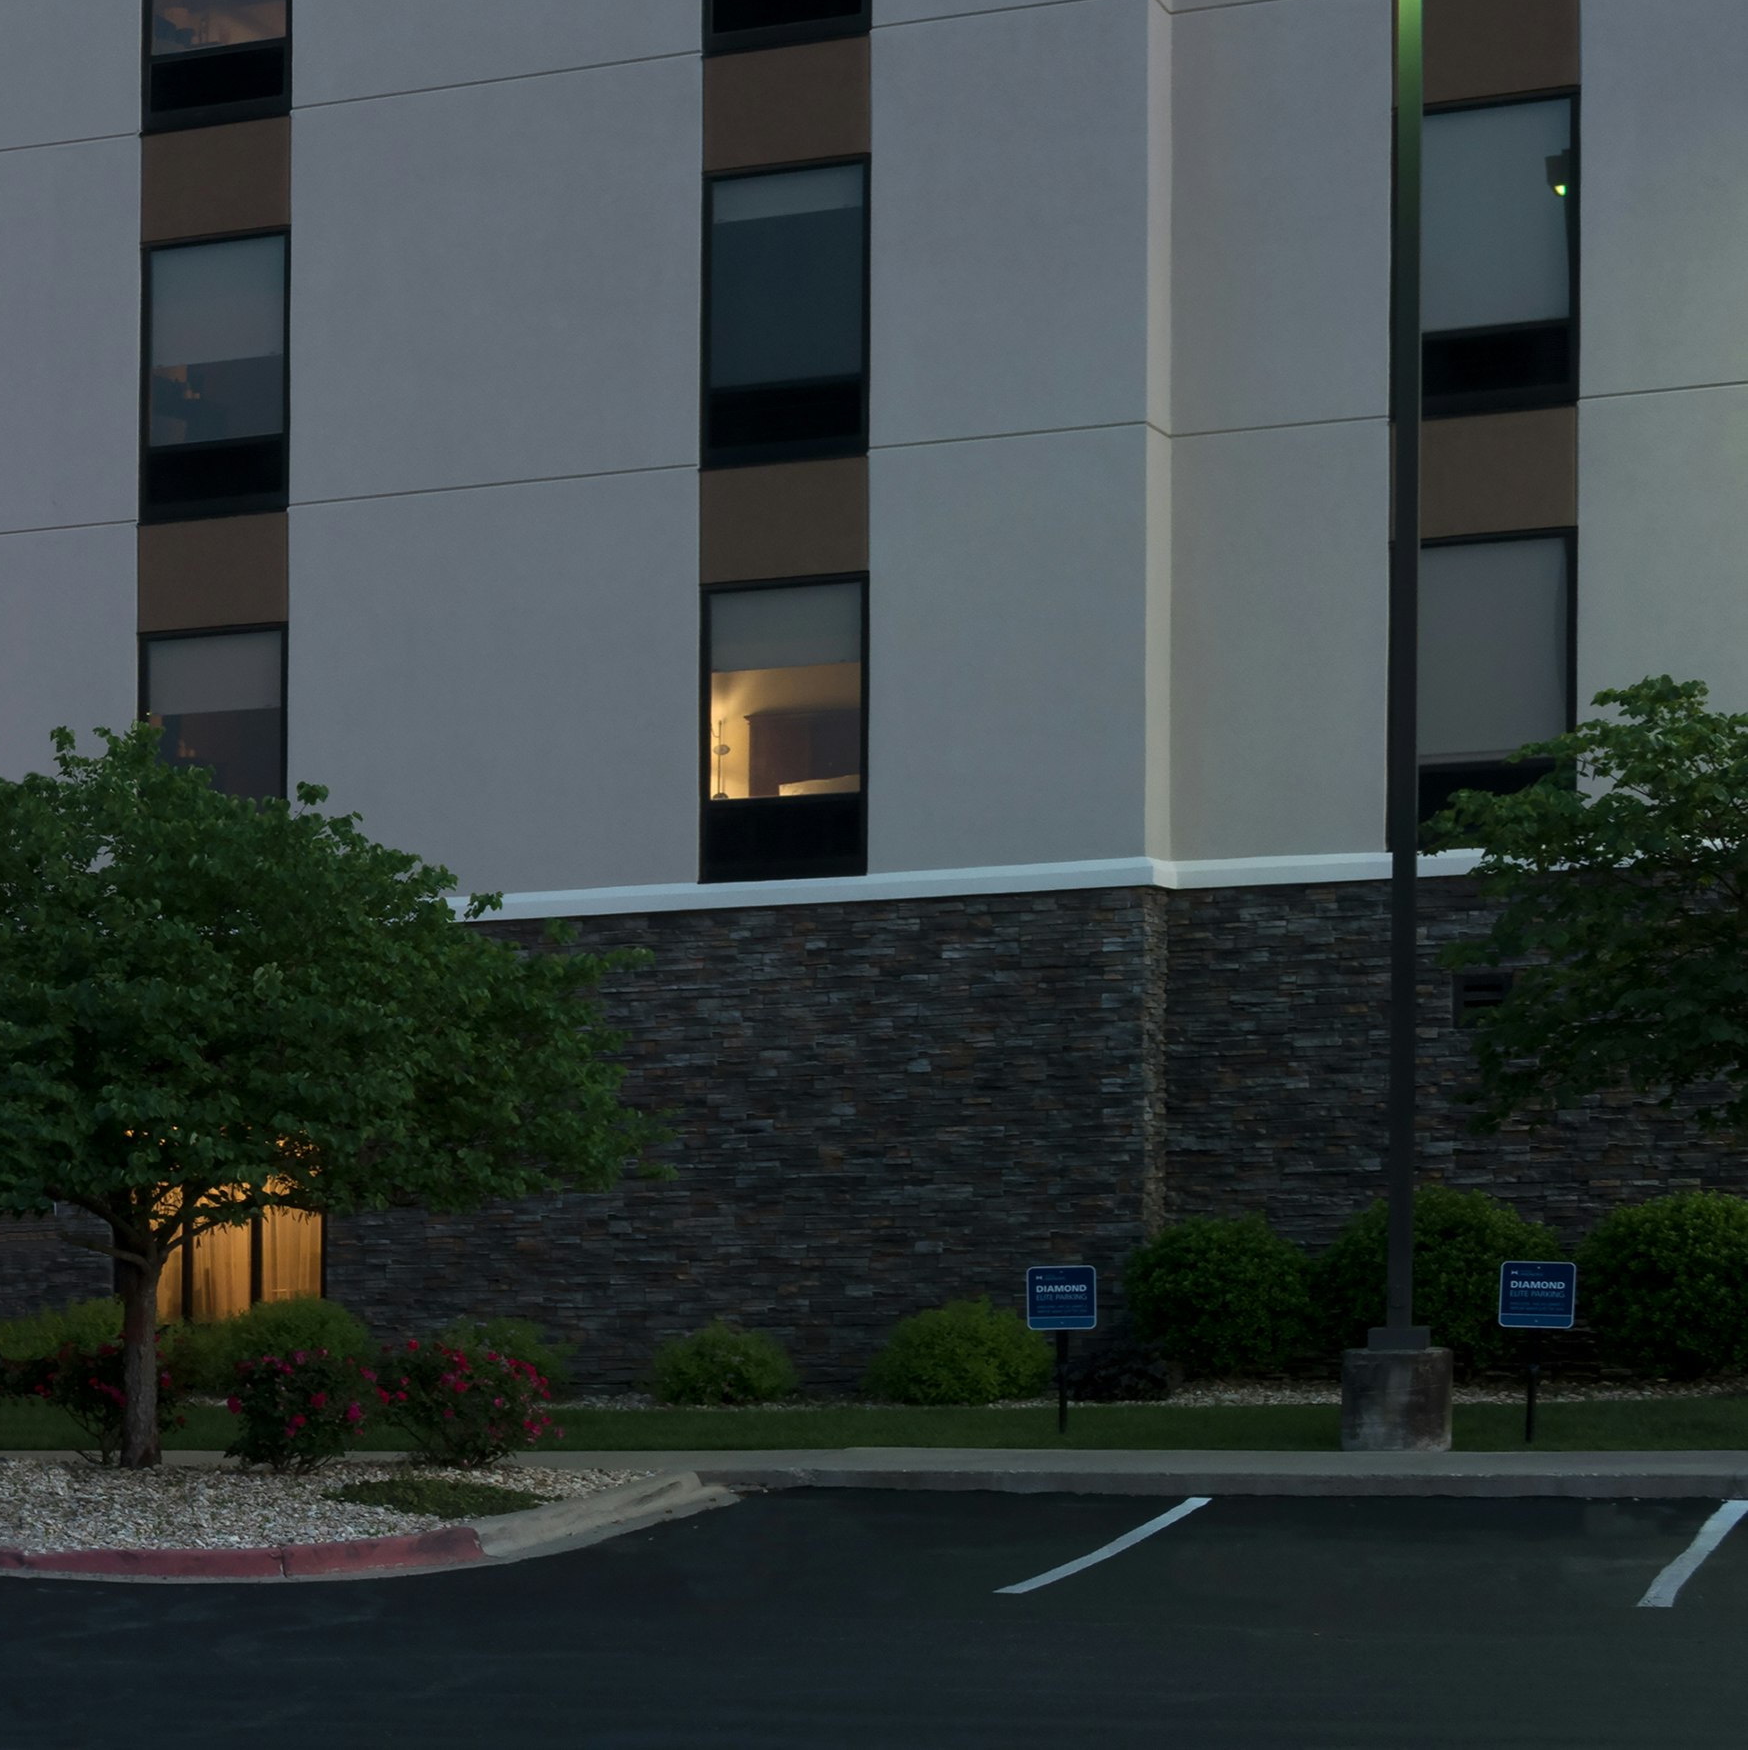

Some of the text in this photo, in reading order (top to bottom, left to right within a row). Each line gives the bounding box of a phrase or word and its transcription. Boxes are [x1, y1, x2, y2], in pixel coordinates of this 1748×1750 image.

[1035, 1284, 1088, 1293] DIAMOND
[1510, 1280, 1566, 1290] DIAMOND
[1055, 1292, 1088, 1301] PARKING
